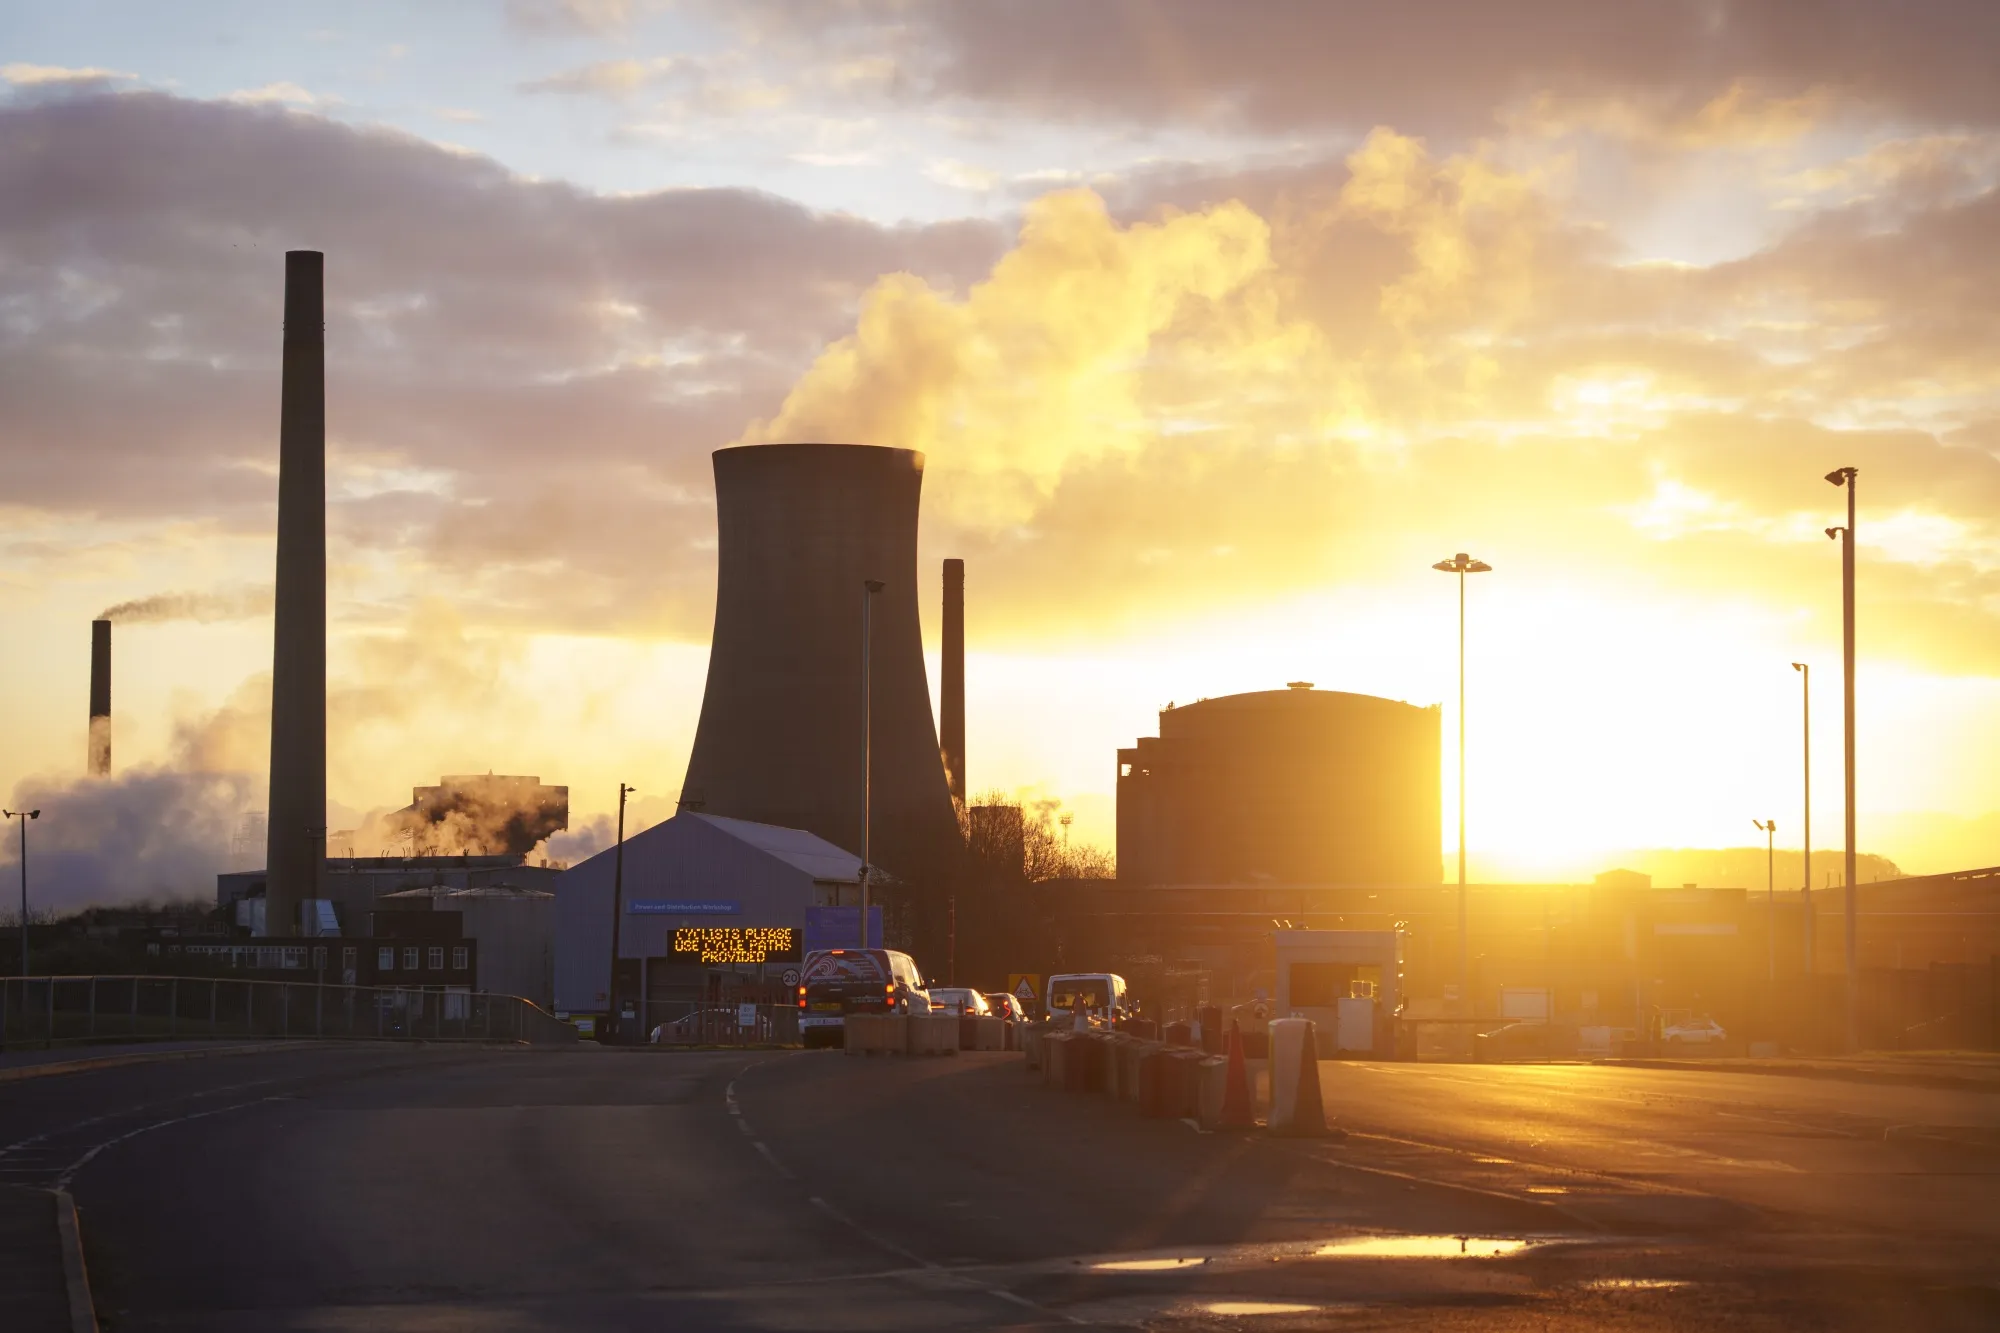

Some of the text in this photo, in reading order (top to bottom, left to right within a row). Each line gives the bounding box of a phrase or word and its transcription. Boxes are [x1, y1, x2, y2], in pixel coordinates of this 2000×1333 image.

[703, 903, 732, 911] Workshop
[677, 928, 792, 940] CYCLISTS PLEASE
[675, 939, 792, 951] USE CYCLE PATHS
[701, 951, 766, 962] PROVIDED
[784, 974, 798, 983] 20
